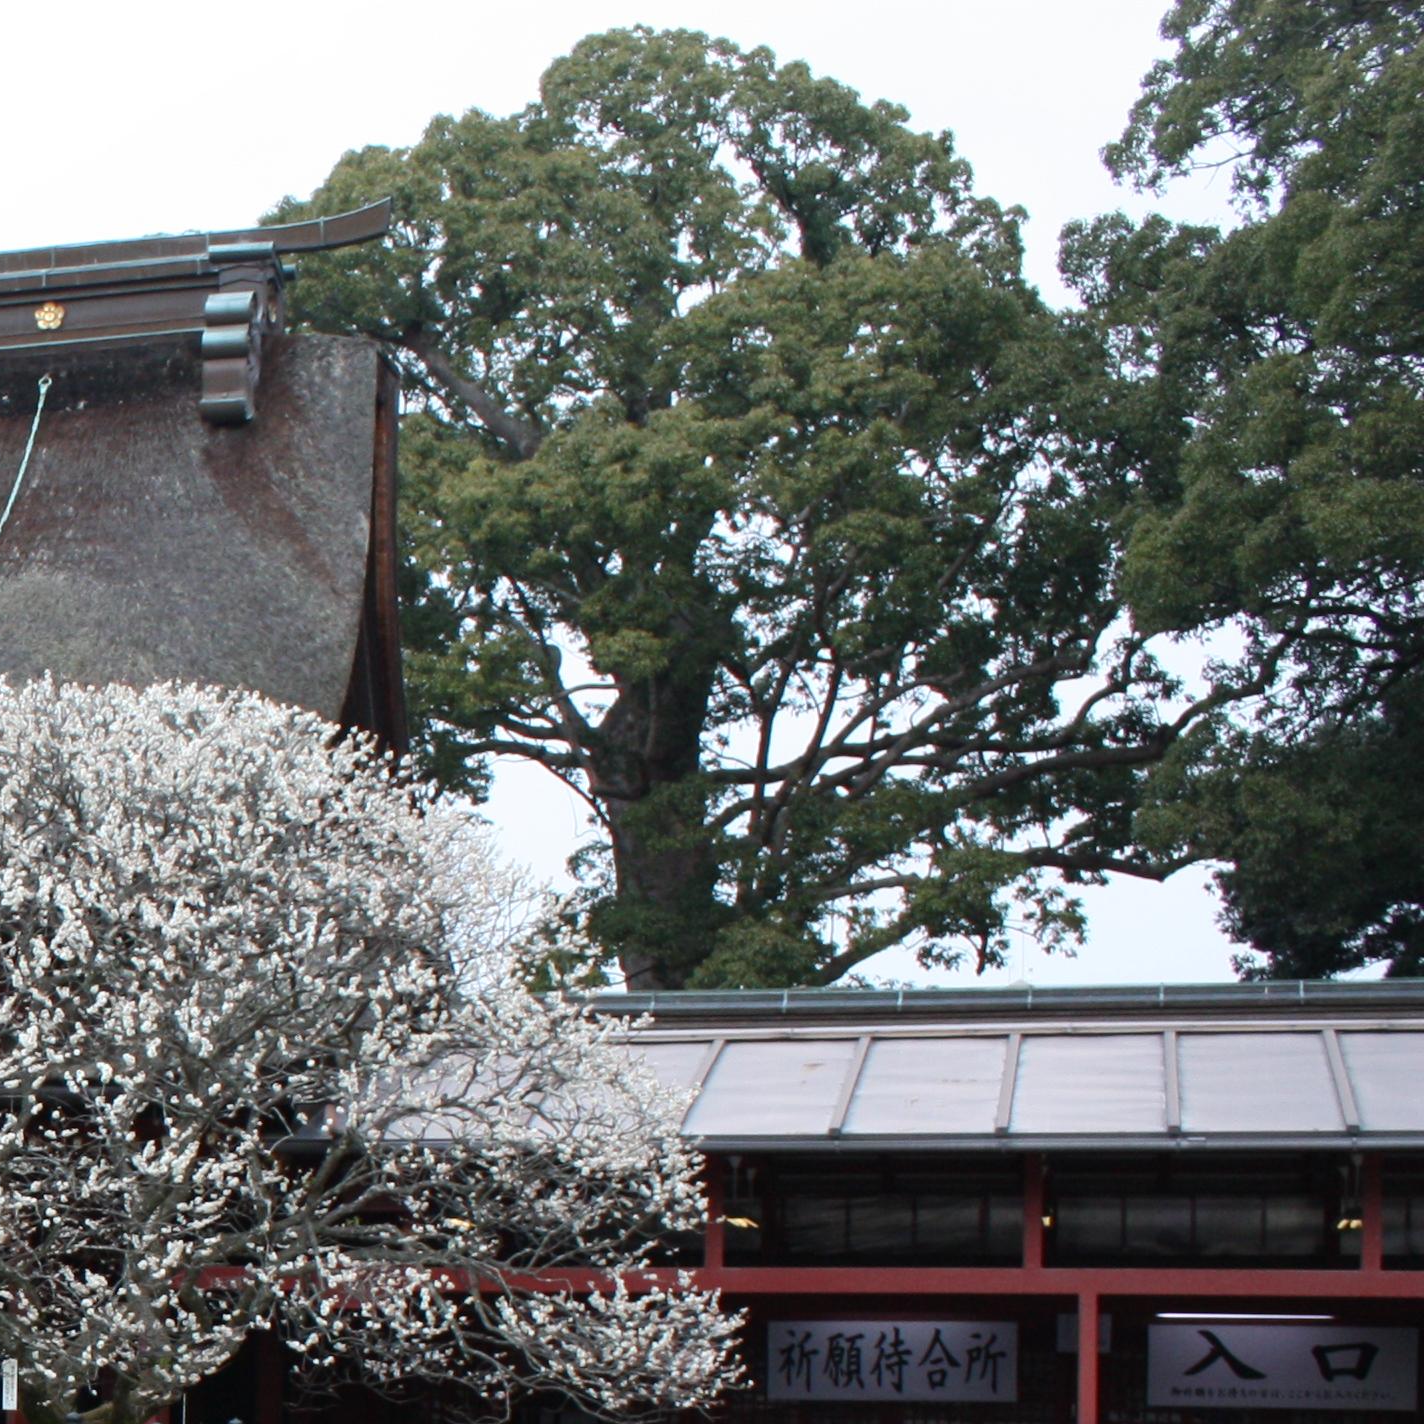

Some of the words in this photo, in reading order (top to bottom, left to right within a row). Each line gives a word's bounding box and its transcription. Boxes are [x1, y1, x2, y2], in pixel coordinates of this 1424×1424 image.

[778, 1327, 1006, 1393] 祈願待合所
[1182, 1329, 1379, 1382] 入口
